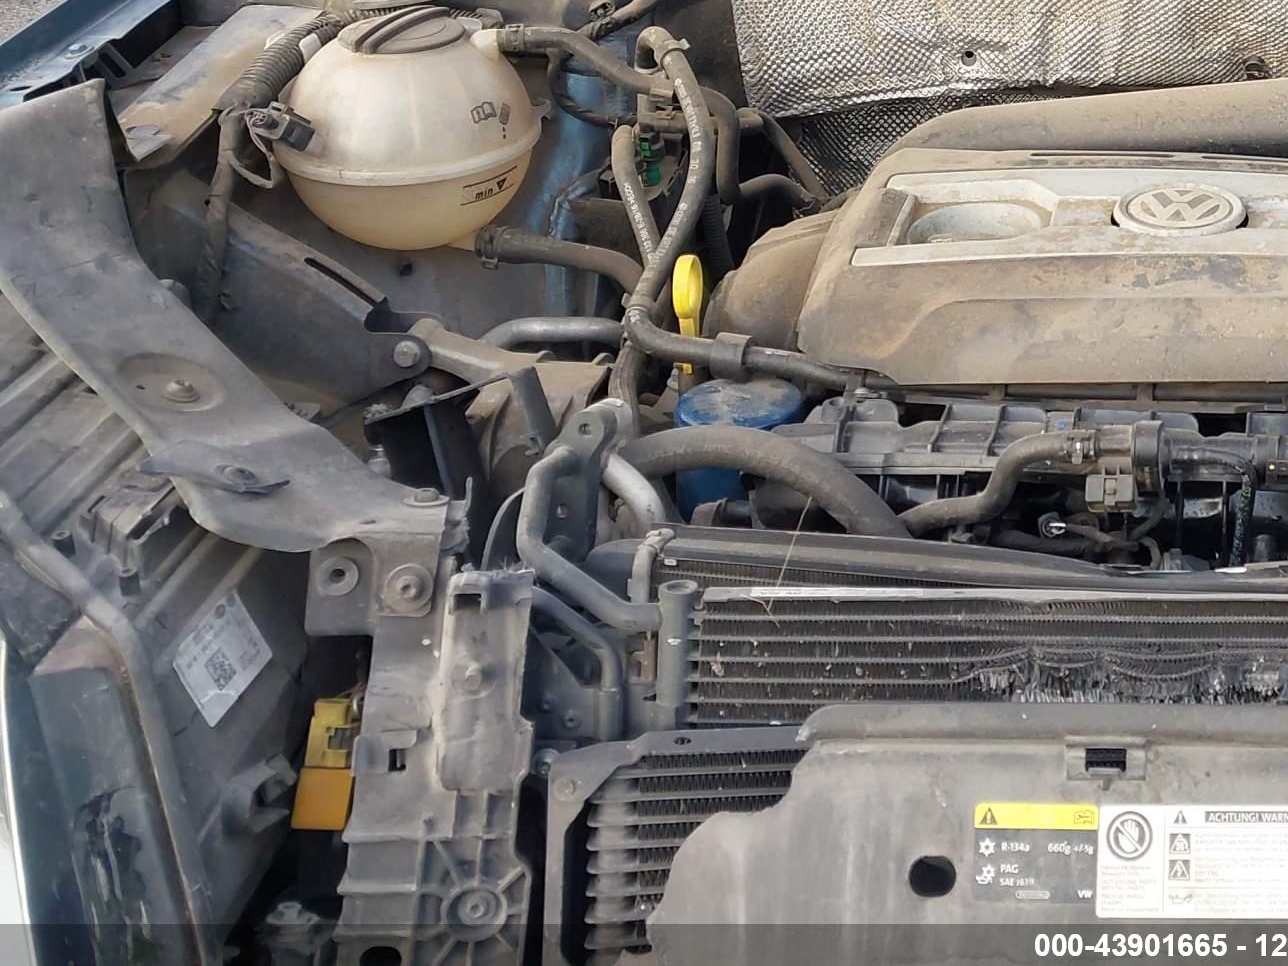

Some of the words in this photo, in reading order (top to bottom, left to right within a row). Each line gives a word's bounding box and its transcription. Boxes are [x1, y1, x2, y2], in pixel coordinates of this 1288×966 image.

[475, 188, 493, 199] min
[1208, 812, 1258, 822] ACHTUNG!
[1001, 842, 1030, 852] R-134a
[1000, 864, 1019, 873] PAG
[1000, 878, 1014, 886] SAE
[1077, 890, 1093, 898] VW
